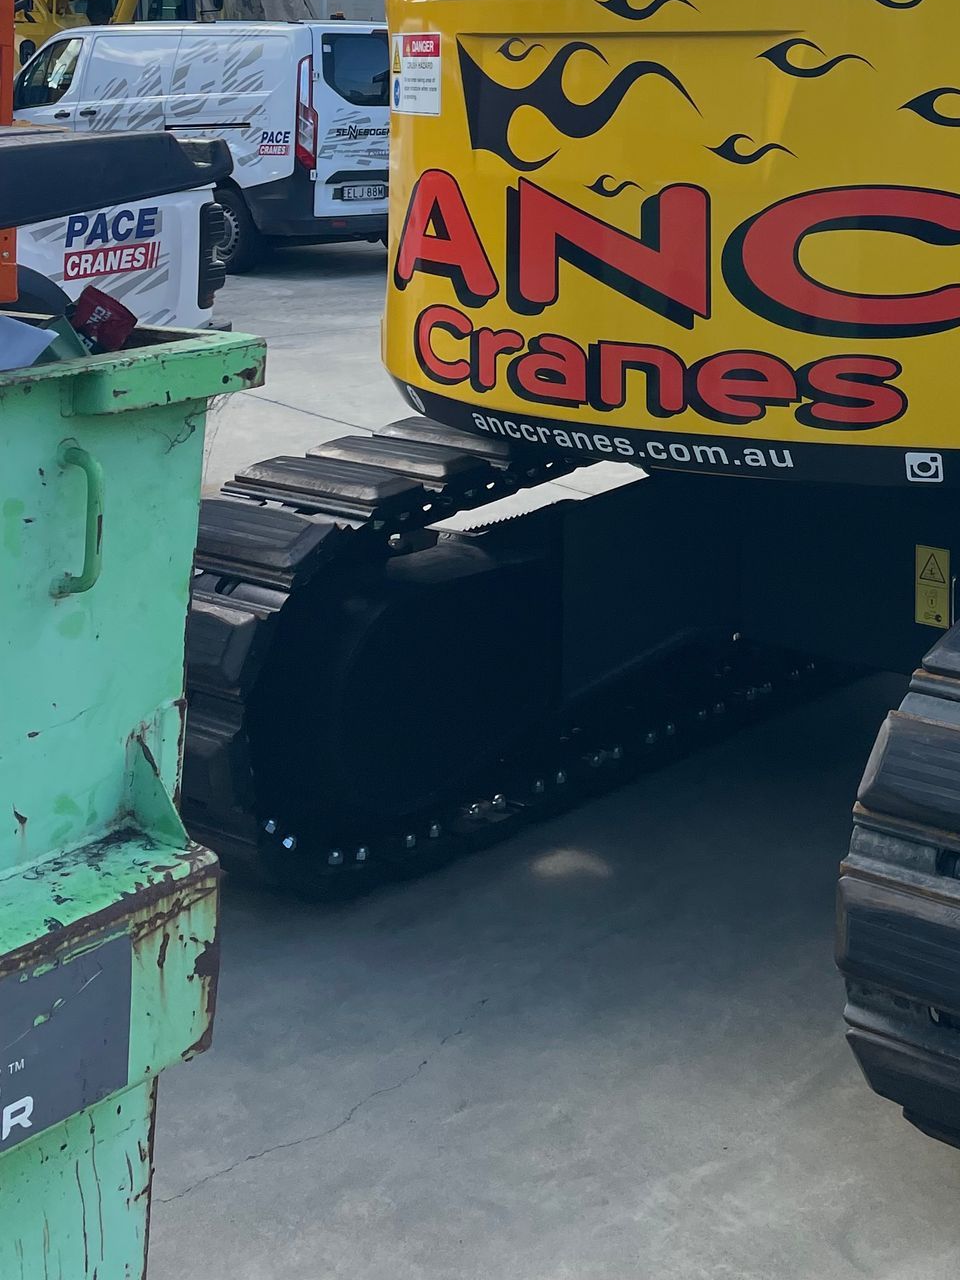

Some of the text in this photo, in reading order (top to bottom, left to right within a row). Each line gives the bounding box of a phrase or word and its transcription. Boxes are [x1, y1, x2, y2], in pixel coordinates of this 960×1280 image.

[411, 40, 435, 53] DANGER
[259, 145, 286, 155] CRANES
[260, 131, 291, 144] PACE
[65, 207, 159, 248] PACE
[66, 247, 146, 277] CRANES
[414, 305, 909, 432] Cranes
[472, 410, 795, 468] anccranes.com.au
